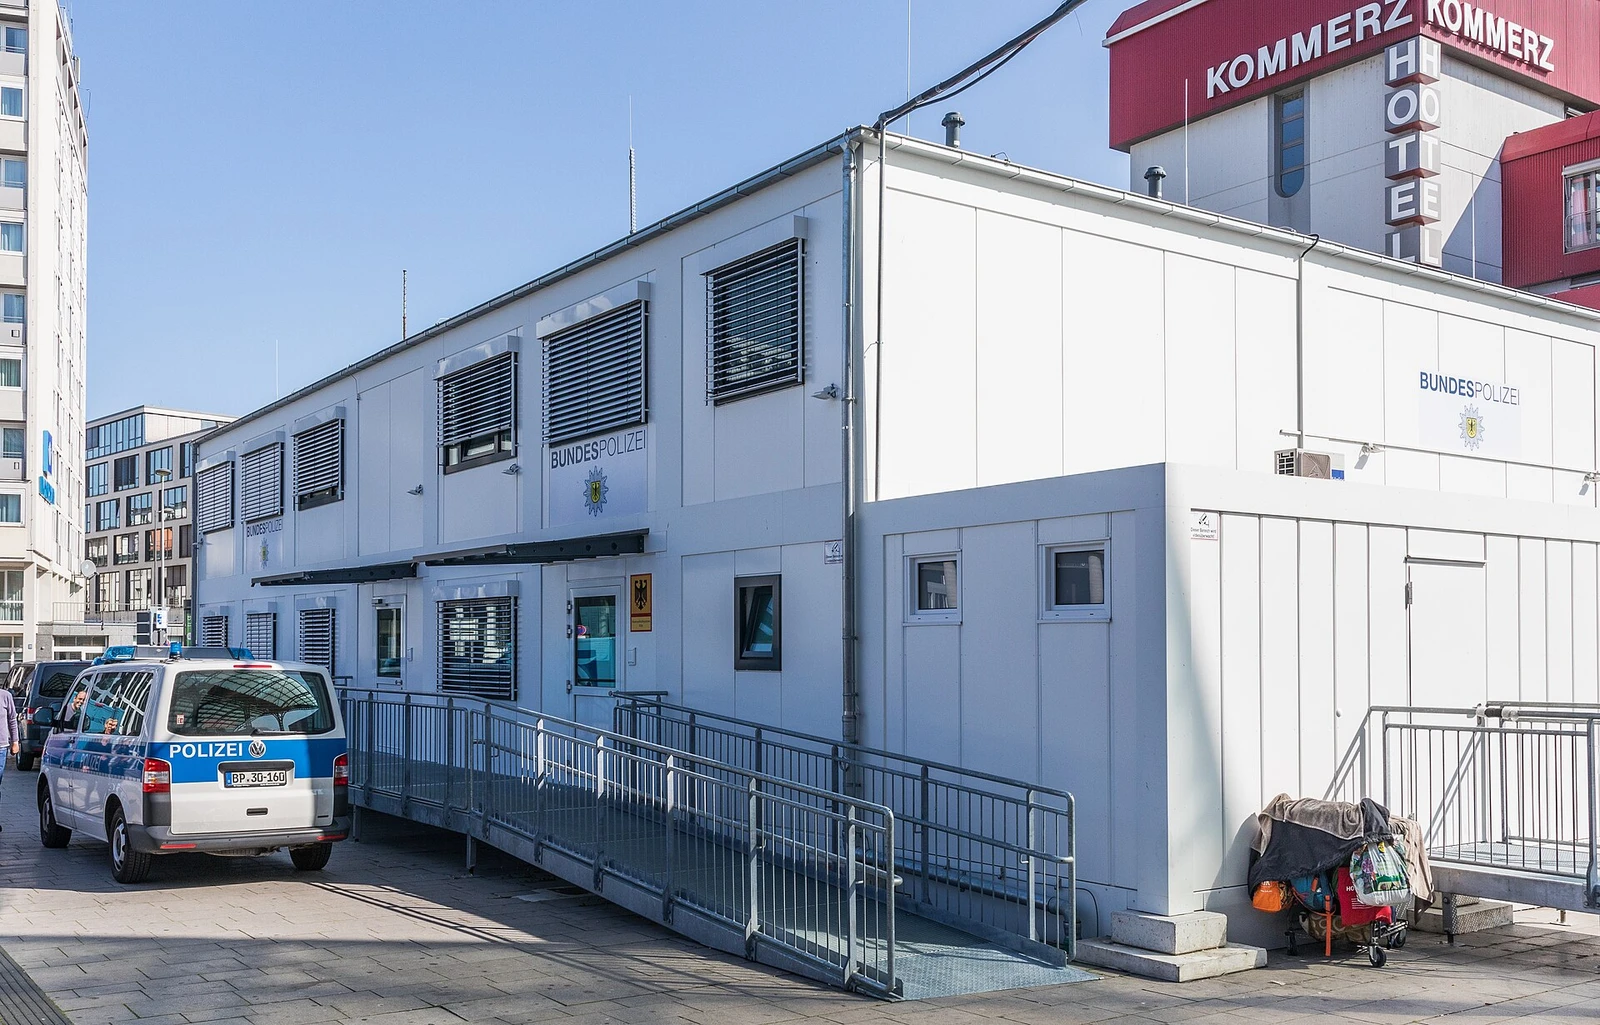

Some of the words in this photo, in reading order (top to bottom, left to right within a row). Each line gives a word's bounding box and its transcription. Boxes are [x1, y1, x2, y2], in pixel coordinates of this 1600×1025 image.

[1206, 0, 1413, 99] KOMMERZ
[1427, 0, 1555, 72] KOMMERZ
[1387, 40, 1418, 262] HOTEL
[1420, 40, 1440, 264] HOTEL
[1420, 371, 1520, 406] BUNDESPOLIZEI
[551, 429, 646, 469] BUNDESPOLIZEI
[169, 742, 243, 759] POLIZEI
